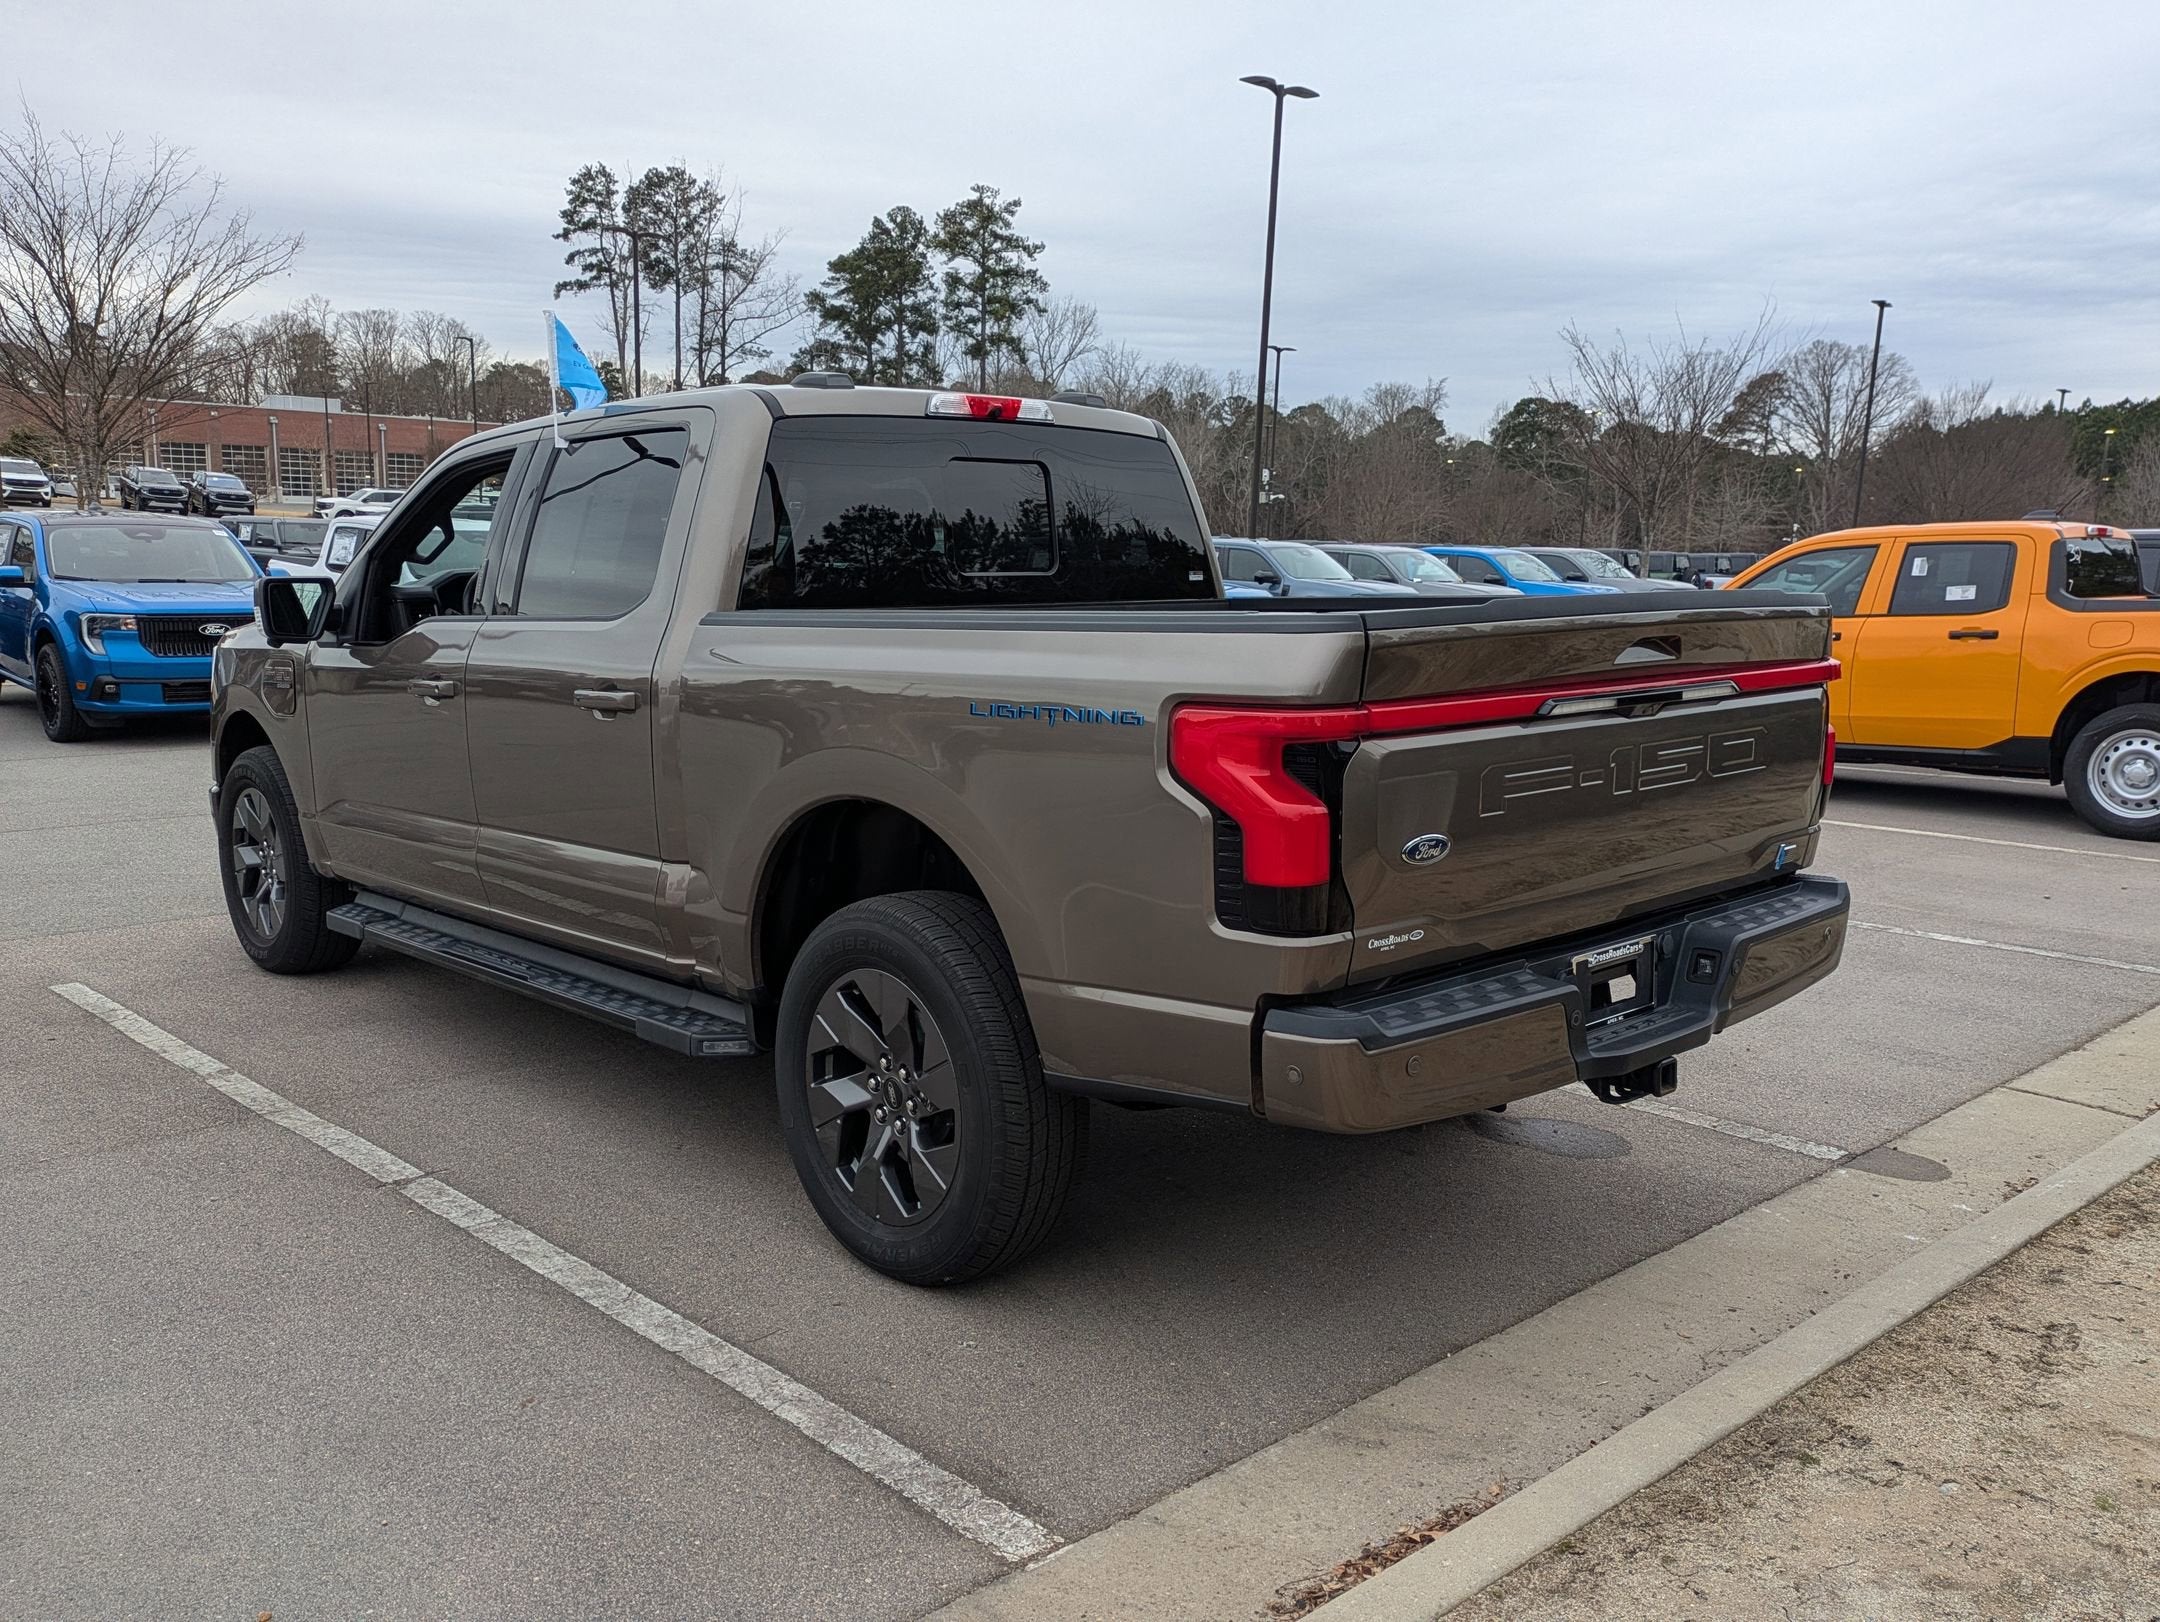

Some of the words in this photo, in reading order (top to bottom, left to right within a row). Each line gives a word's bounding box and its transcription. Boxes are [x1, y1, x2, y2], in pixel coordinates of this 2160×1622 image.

[205, 625, 225, 633] Ford
[969, 702, 1145, 727] LIGHTNING
[1479, 726, 1768, 817] F-150
[1415, 840, 1443, 860] Ford
